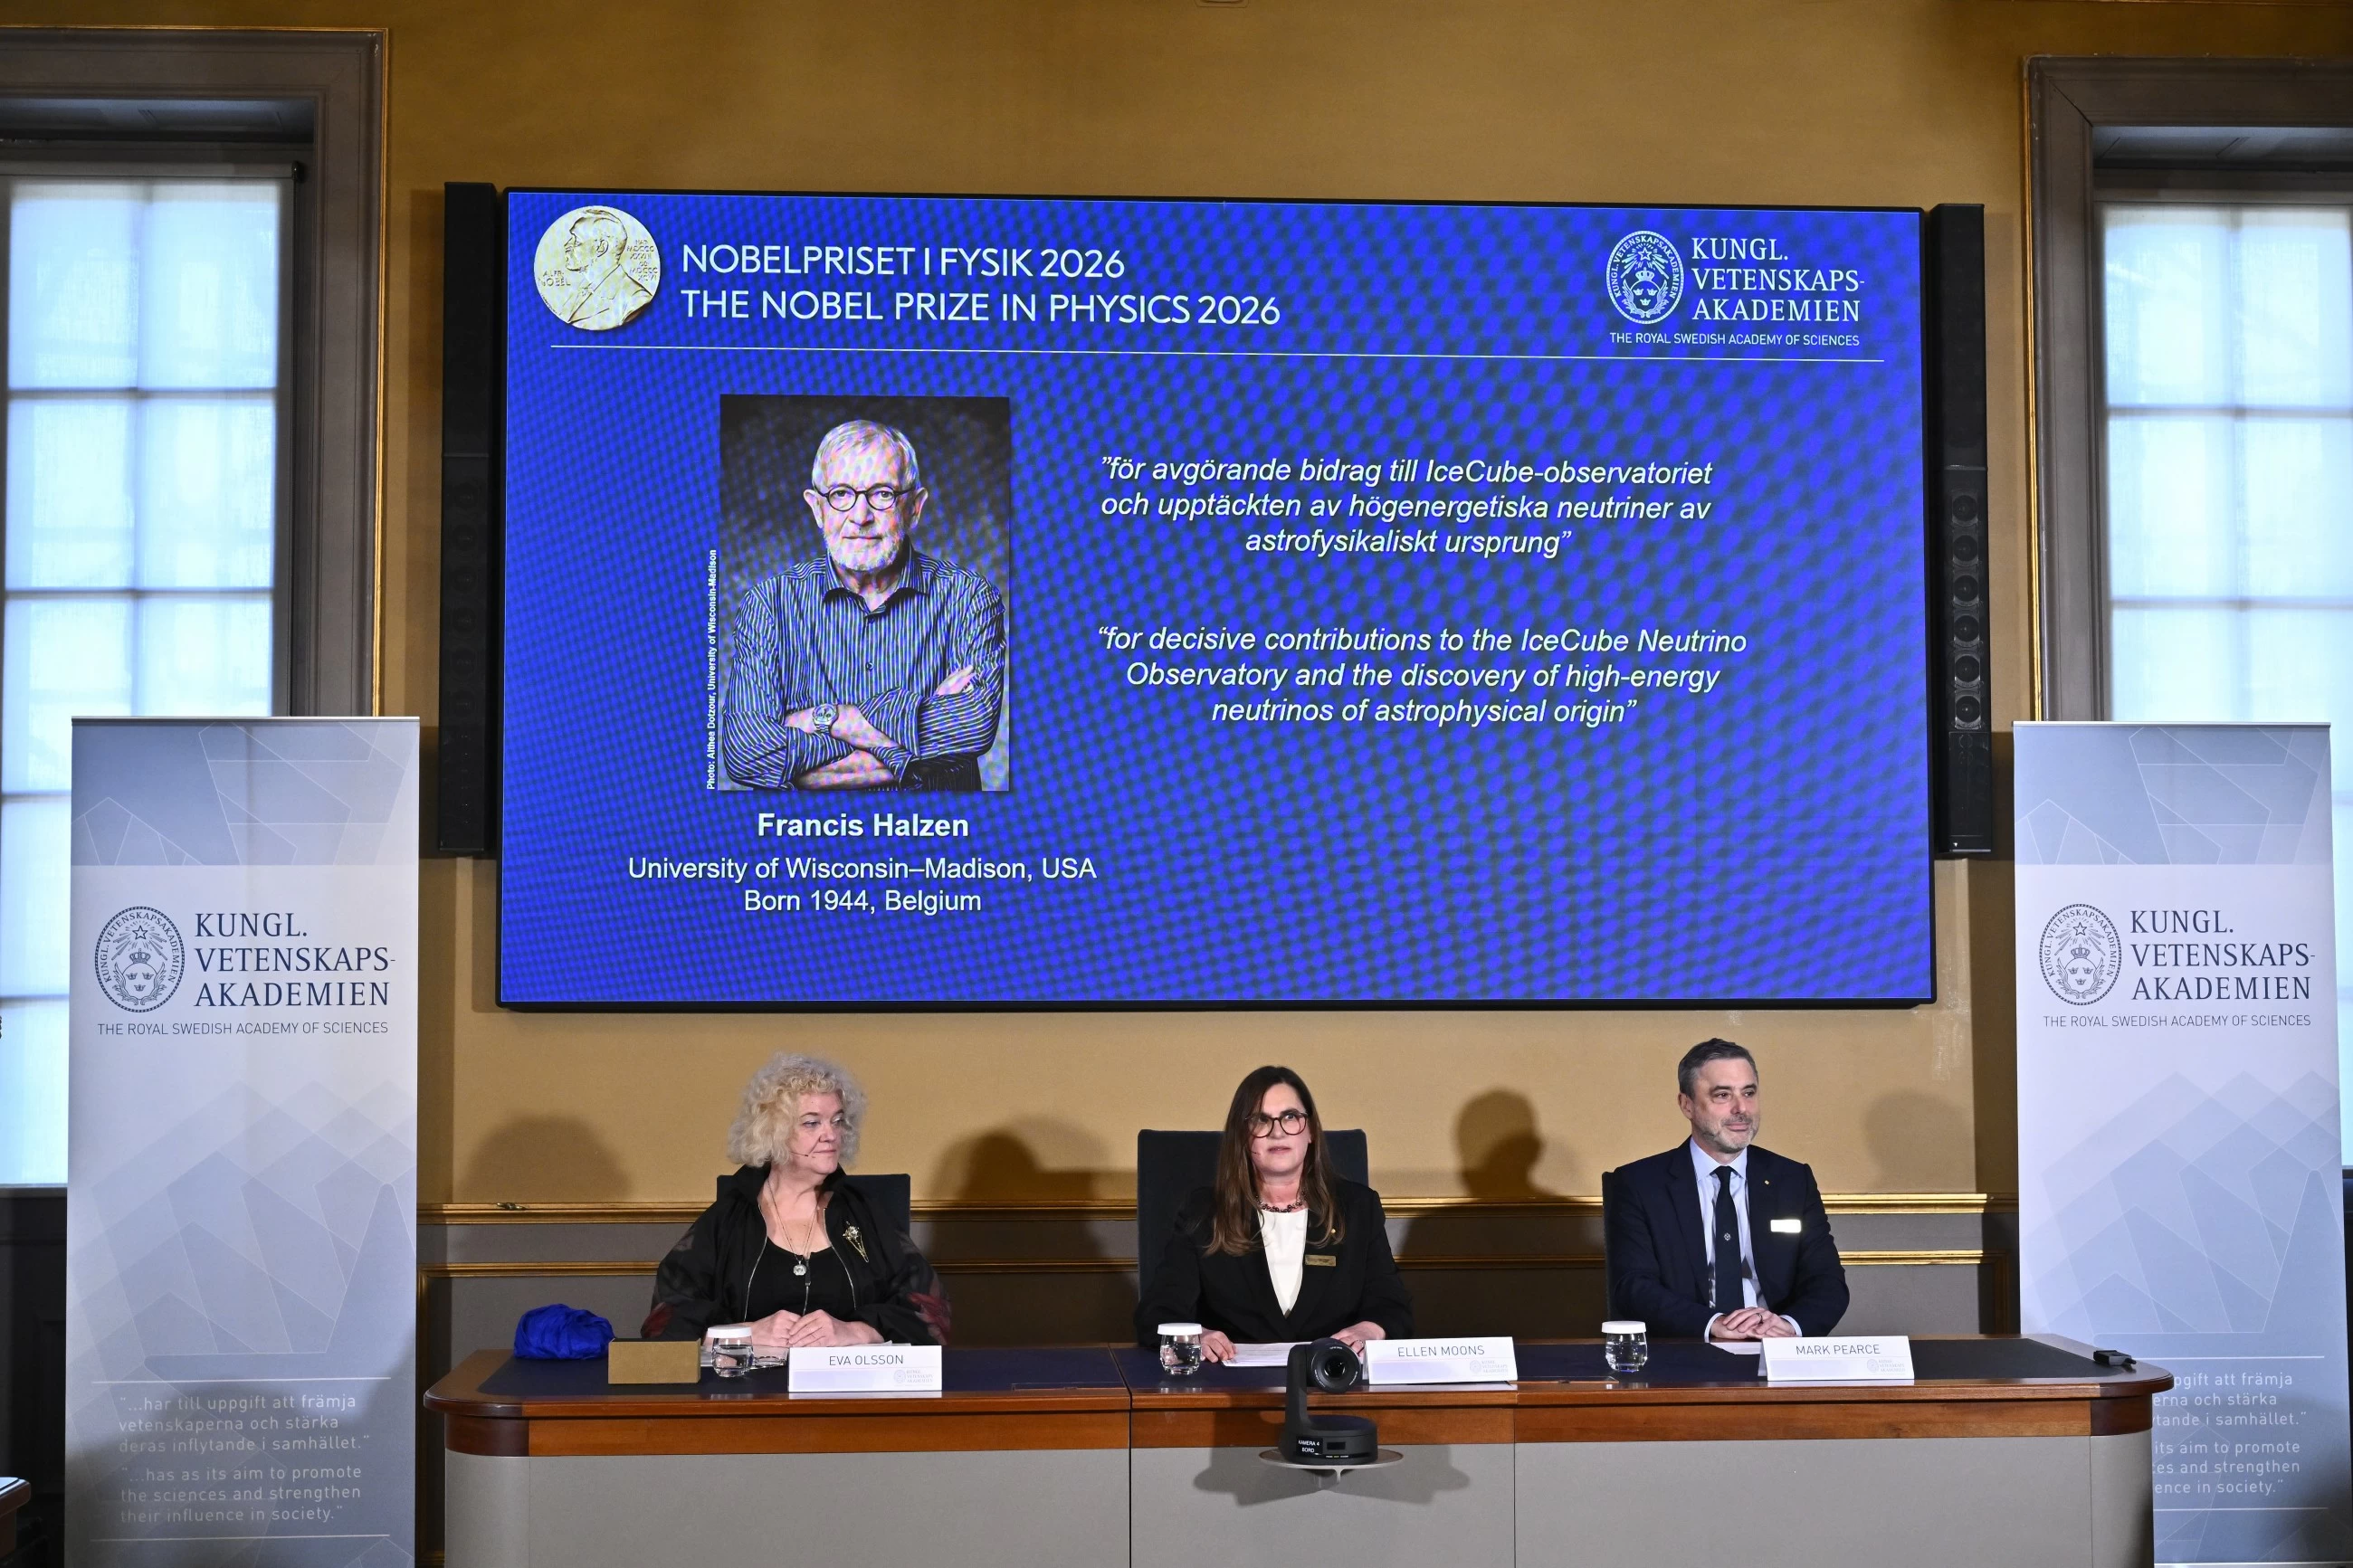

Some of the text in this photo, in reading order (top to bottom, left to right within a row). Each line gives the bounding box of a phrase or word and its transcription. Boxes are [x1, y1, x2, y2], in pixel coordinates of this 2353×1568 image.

[1692, 238, 1787, 260] KUNGL.
[684, 245, 1124, 278] NOBELPRISET I FYSIK 2026
[1691, 269, 1864, 291] VETENSKAPS-
[681, 290, 1280, 324] THE NOBEL PRIZE IN PHYSICS 2026
[1692, 299, 1860, 321] AKADEMIEN
[1610, 333, 1859, 346] THE ROYAL SWEDISH ACADEMY OF SCIENCES
[1153, 459, 1291, 485] avgörande
[1300, 459, 1381, 487] bidrag
[1390, 460, 1418, 481] till
[1426, 460, 1712, 484] IceCube-observatoriet
[1102, 492, 1711, 522] och upptäckten av högenergetiska neutriner av
[1246, 529, 1437, 556] astrofysikaliskt
[1149, 627, 1255, 649] decisive
[1265, 628, 1431, 651] contributions
[1441, 629, 1463, 651] to
[1472, 629, 1511, 651] the
[1521, 629, 1628, 651] IceCube
[1638, 630, 1746, 651] Neutrino
[707, 549, 717, 790] Photo: Althea Dotzour, University of Wisconsin-Madison
[1128, 662, 1720, 692] Observatory and the discovery of high-energy
[1213, 698, 1333, 720] neutrinos
[1342, 698, 1369, 720] of
[1375, 699, 1547, 727] astrophysical
[759, 813, 967, 836] Francis Halzen
[630, 858, 748, 883] University
[756, 858, 779, 878] of
[1043, 858, 1097, 878] USA
[746, 890, 980, 916] Born 1944, Belgium
[195, 913, 307, 936] KUNGL.
[2131, 910, 2233, 933] KUNGL.
[195, 947, 395, 972] VETENSKAPS-
[2130, 944, 2315, 966] VETENSKAPS-
[194, 983, 389, 1006] AKADEMIEN
[2132, 977, 2310, 1000] AKADEMIEN
[98, 1022, 387, 1034] THE ROYAL SWEDISH ACADEMY OF SCIENCES
[2043, 1015, 2310, 1027] THE ROYAL SWEDISH ACADEMY OF SCIENCES
[830, 1355, 902, 1365] EVA OLSSON
[1398, 1345, 1484, 1356] ELLEN MOONS
[1796, 1345, 1880, 1354] MARK PEARCE
[2215, 1373, 2234, 1385] att
[2243, 1373, 2291, 1388] främja
[178, 1396, 201, 1411] till
[208, 1396, 265, 1412] uppgift
[273, 1397, 294, 1408] att
[302, 1394, 355, 1411] främja
[2195, 1393, 2220, 1405] och
[2228, 1392, 2276, 1405] stärka
[119, 1415, 338, 1432] vetenskaperna och stärka
[2205, 1412, 2209, 1426] i
[119, 1439, 166, 1452] deras
[174, 1437, 255, 1454] inflytande
[262, 1437, 265, 1449] i
[2155, 1440, 2301, 1457] its aim to promote
[181, 1471, 200, 1481] as
[206, 1467, 226, 1480] its
[233, 1467, 263, 1480] aim
[271, 1468, 284, 1479] to
[292, 1466, 361, 1482] promote
[2181, 1460, 2207, 1473] and
[2214, 1459, 2300, 1477] strengthen
[121, 1486, 360, 1502] the sciences and strengthen
[2197, 1480, 2211, 1494] in
[120, 1508, 160, 1523] their
[168, 1508, 243, 1522] influence
[251, 1506, 265, 1521] in
